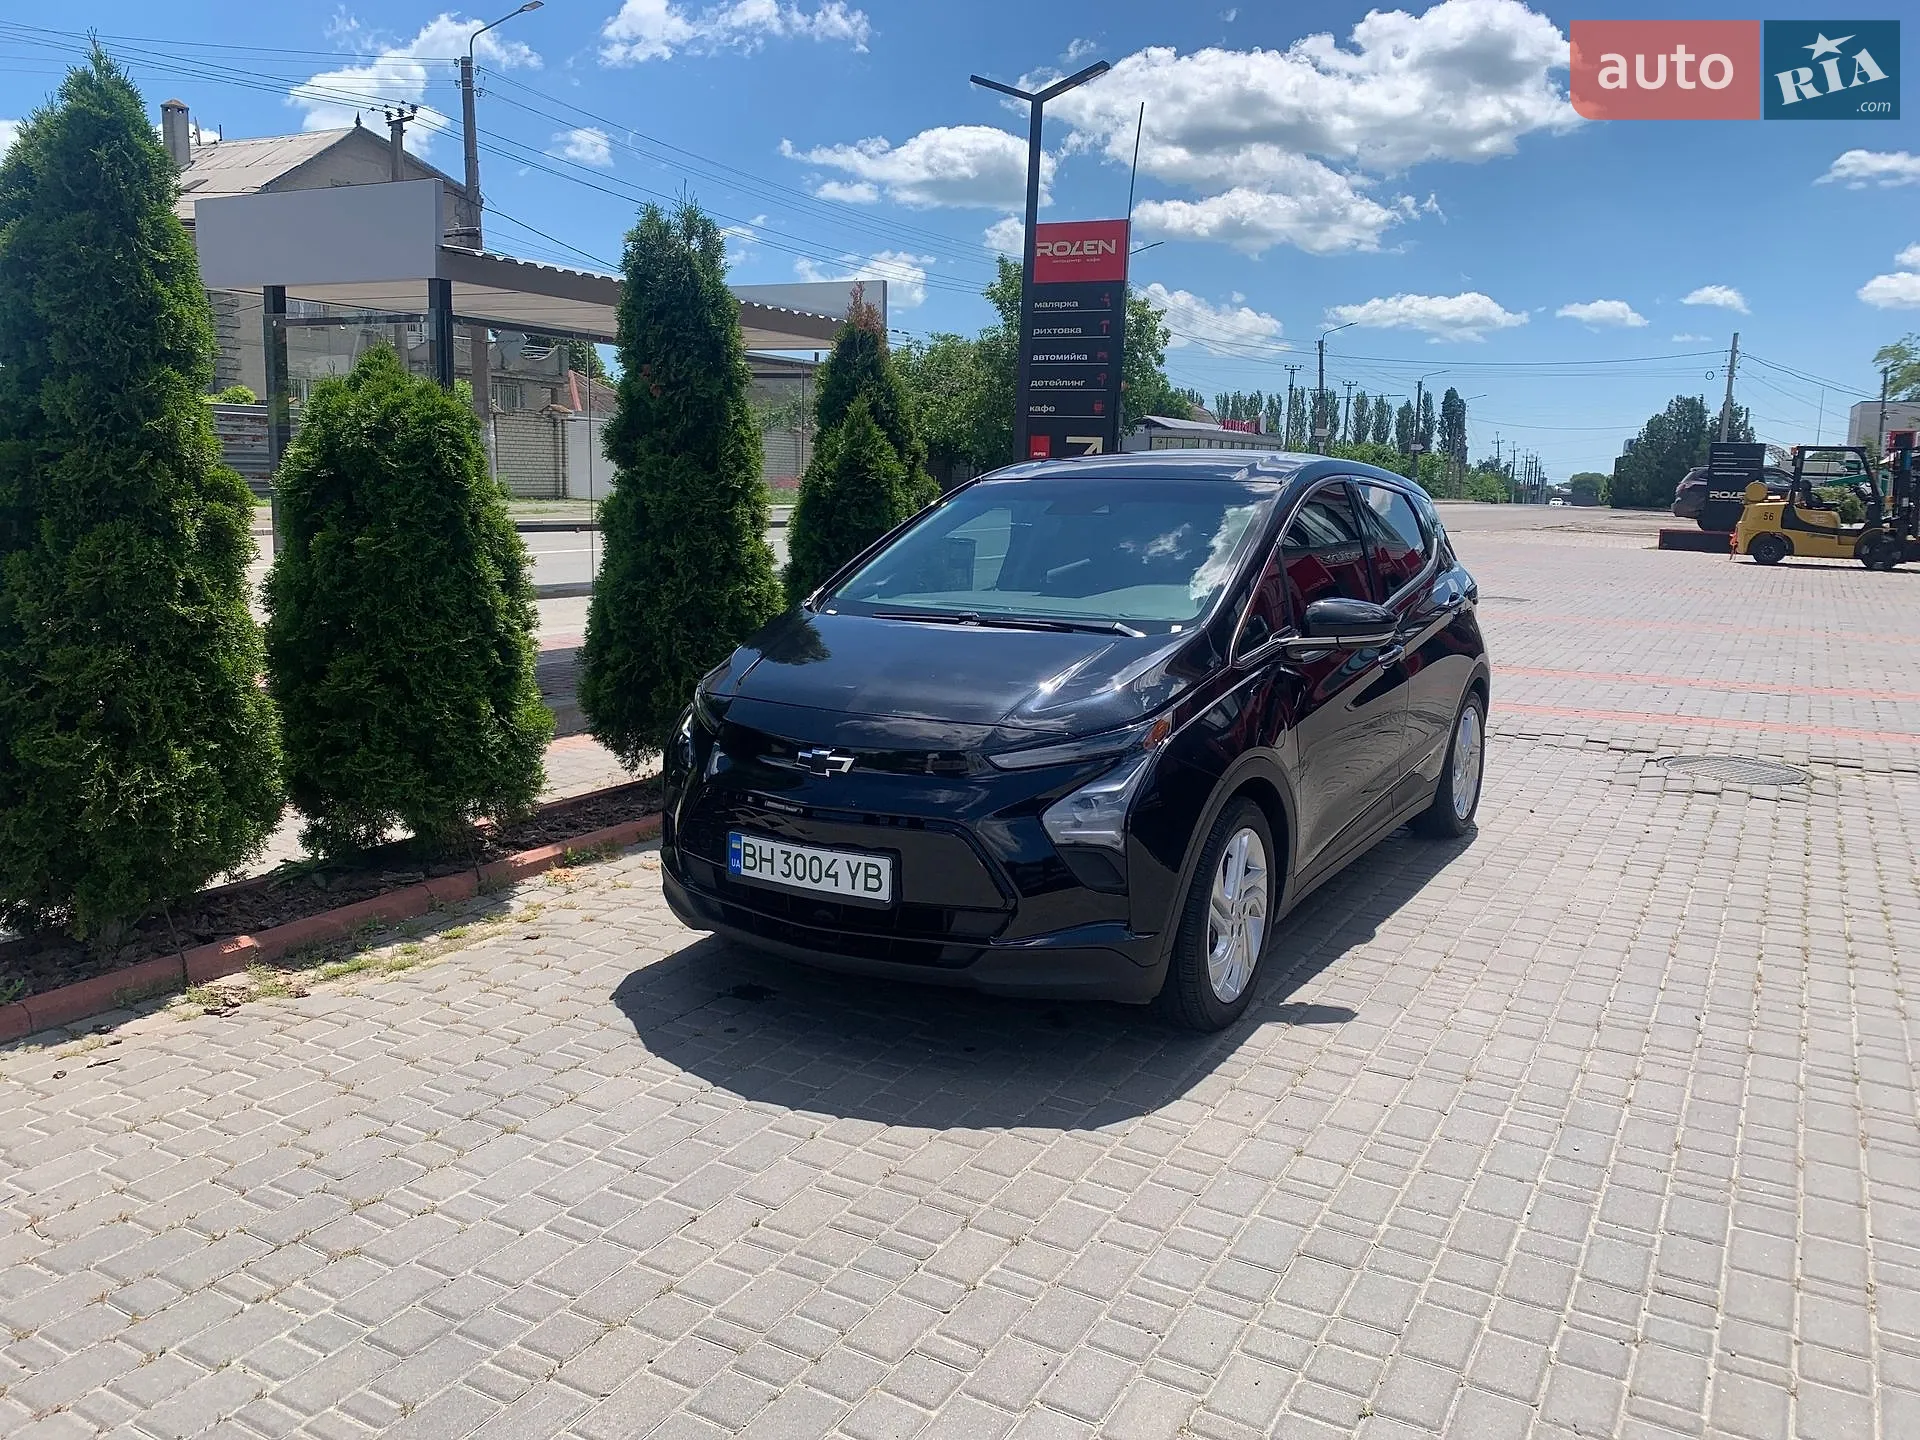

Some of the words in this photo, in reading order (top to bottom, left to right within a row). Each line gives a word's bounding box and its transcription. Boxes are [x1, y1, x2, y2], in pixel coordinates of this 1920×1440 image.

[1036, 239, 1116, 257] ROLEN
[1034, 301, 1079, 309] малярка
[1033, 327, 1082, 336] рихтовка
[1032, 352, 1088, 361] автомийка
[1030, 378, 1086, 387] детейлинг
[1029, 404, 1056, 413] кафе
[1709, 491, 1745, 499] ROLE
[1763, 512, 1774, 521] 56
[731, 858, 741, 869] UA
